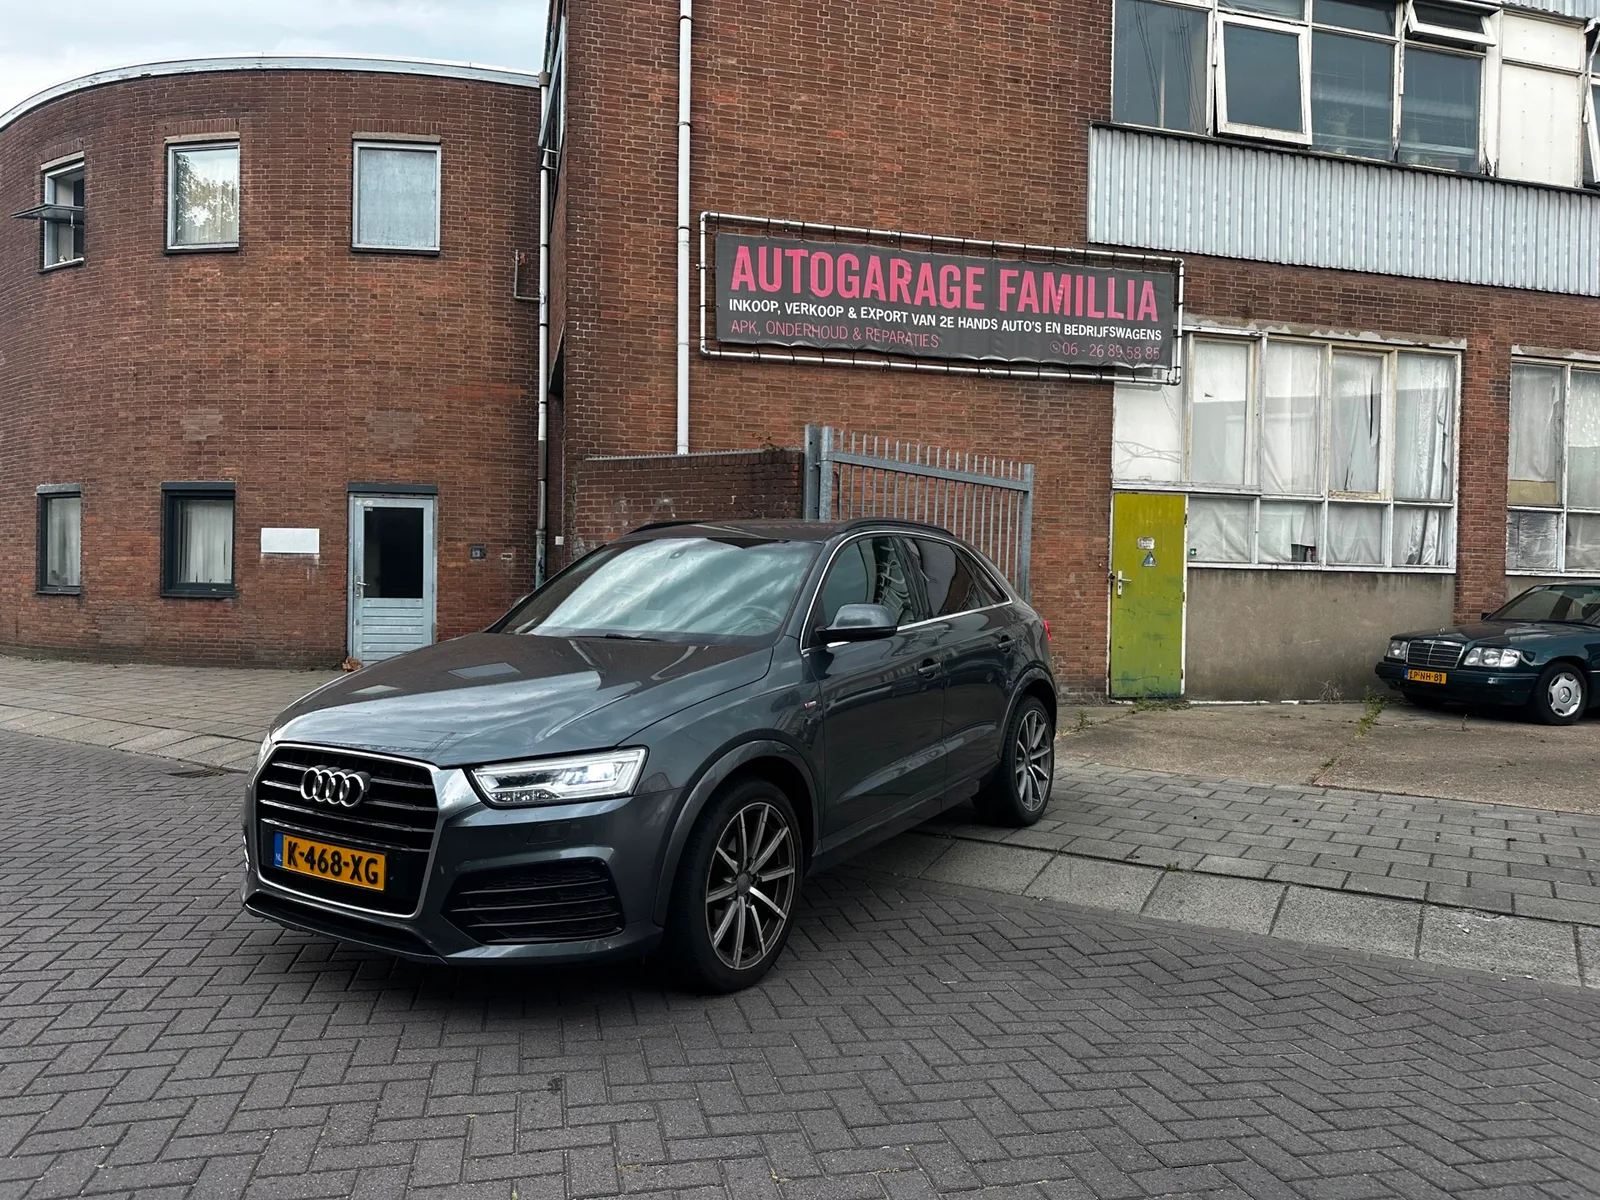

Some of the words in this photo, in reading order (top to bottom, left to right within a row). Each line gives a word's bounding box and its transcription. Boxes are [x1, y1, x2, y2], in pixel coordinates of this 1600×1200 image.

[730, 245, 985, 311] AUTOGARAGE
[999, 268, 1159, 322] FAMILLIA
[729, 298, 781, 315] INKOOP,
[785, 302, 844, 318] VERKOOP
[848, 306, 858, 319] &
[860, 306, 908, 324] EXPORT
[911, 313, 936, 326] VAN
[939, 315, 955, 328] 2E
[958, 316, 998, 330] HANDS
[1001, 319, 1042, 333] AUTO'S
[1045, 321, 1061, 334] EN
[1064, 323, 1162, 341] BEDRIJFSWAGENS
[730, 319, 761, 336] APK,
[765, 320, 849, 340] ONDERHOUD
[852, 327, 862, 341] &
[865, 326, 939, 348] REPARATIES
[1062, 341, 1078, 356] 06
[1089, 343, 1104, 358] 26
[1107, 343, 1122, 358] 89
[1126, 346, 1141, 360] 58
[1145, 346, 1160, 360] 85
[287, 840, 379, 885] K-468-XG
